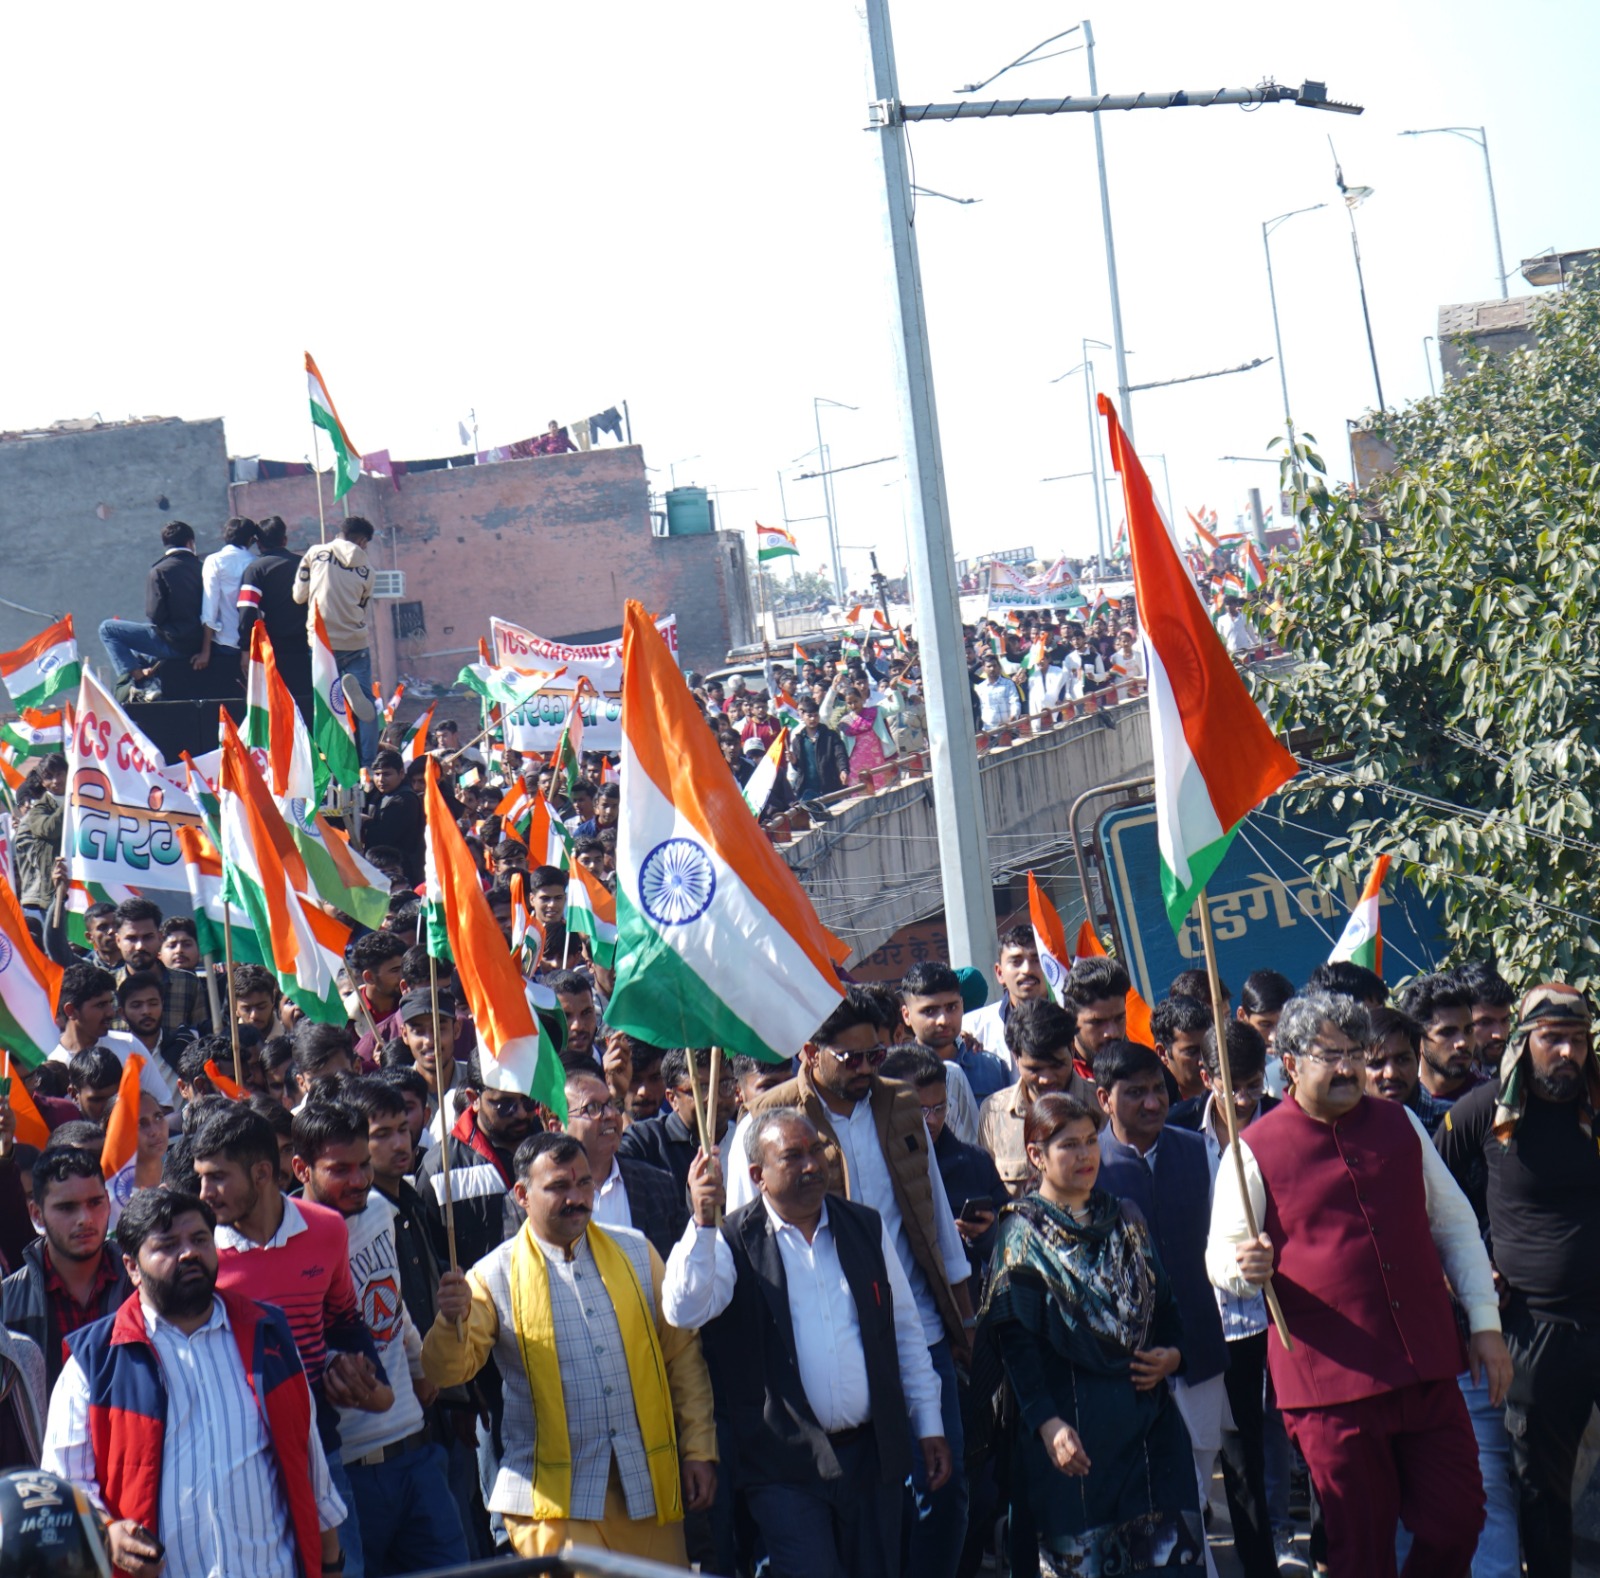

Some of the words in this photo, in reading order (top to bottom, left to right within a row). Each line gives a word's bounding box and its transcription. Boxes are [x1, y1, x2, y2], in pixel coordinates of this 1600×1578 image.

[502, 629, 528, 655] ICS
[72, 711, 111, 762] ICS
[71, 767, 204, 870] तिरंग
